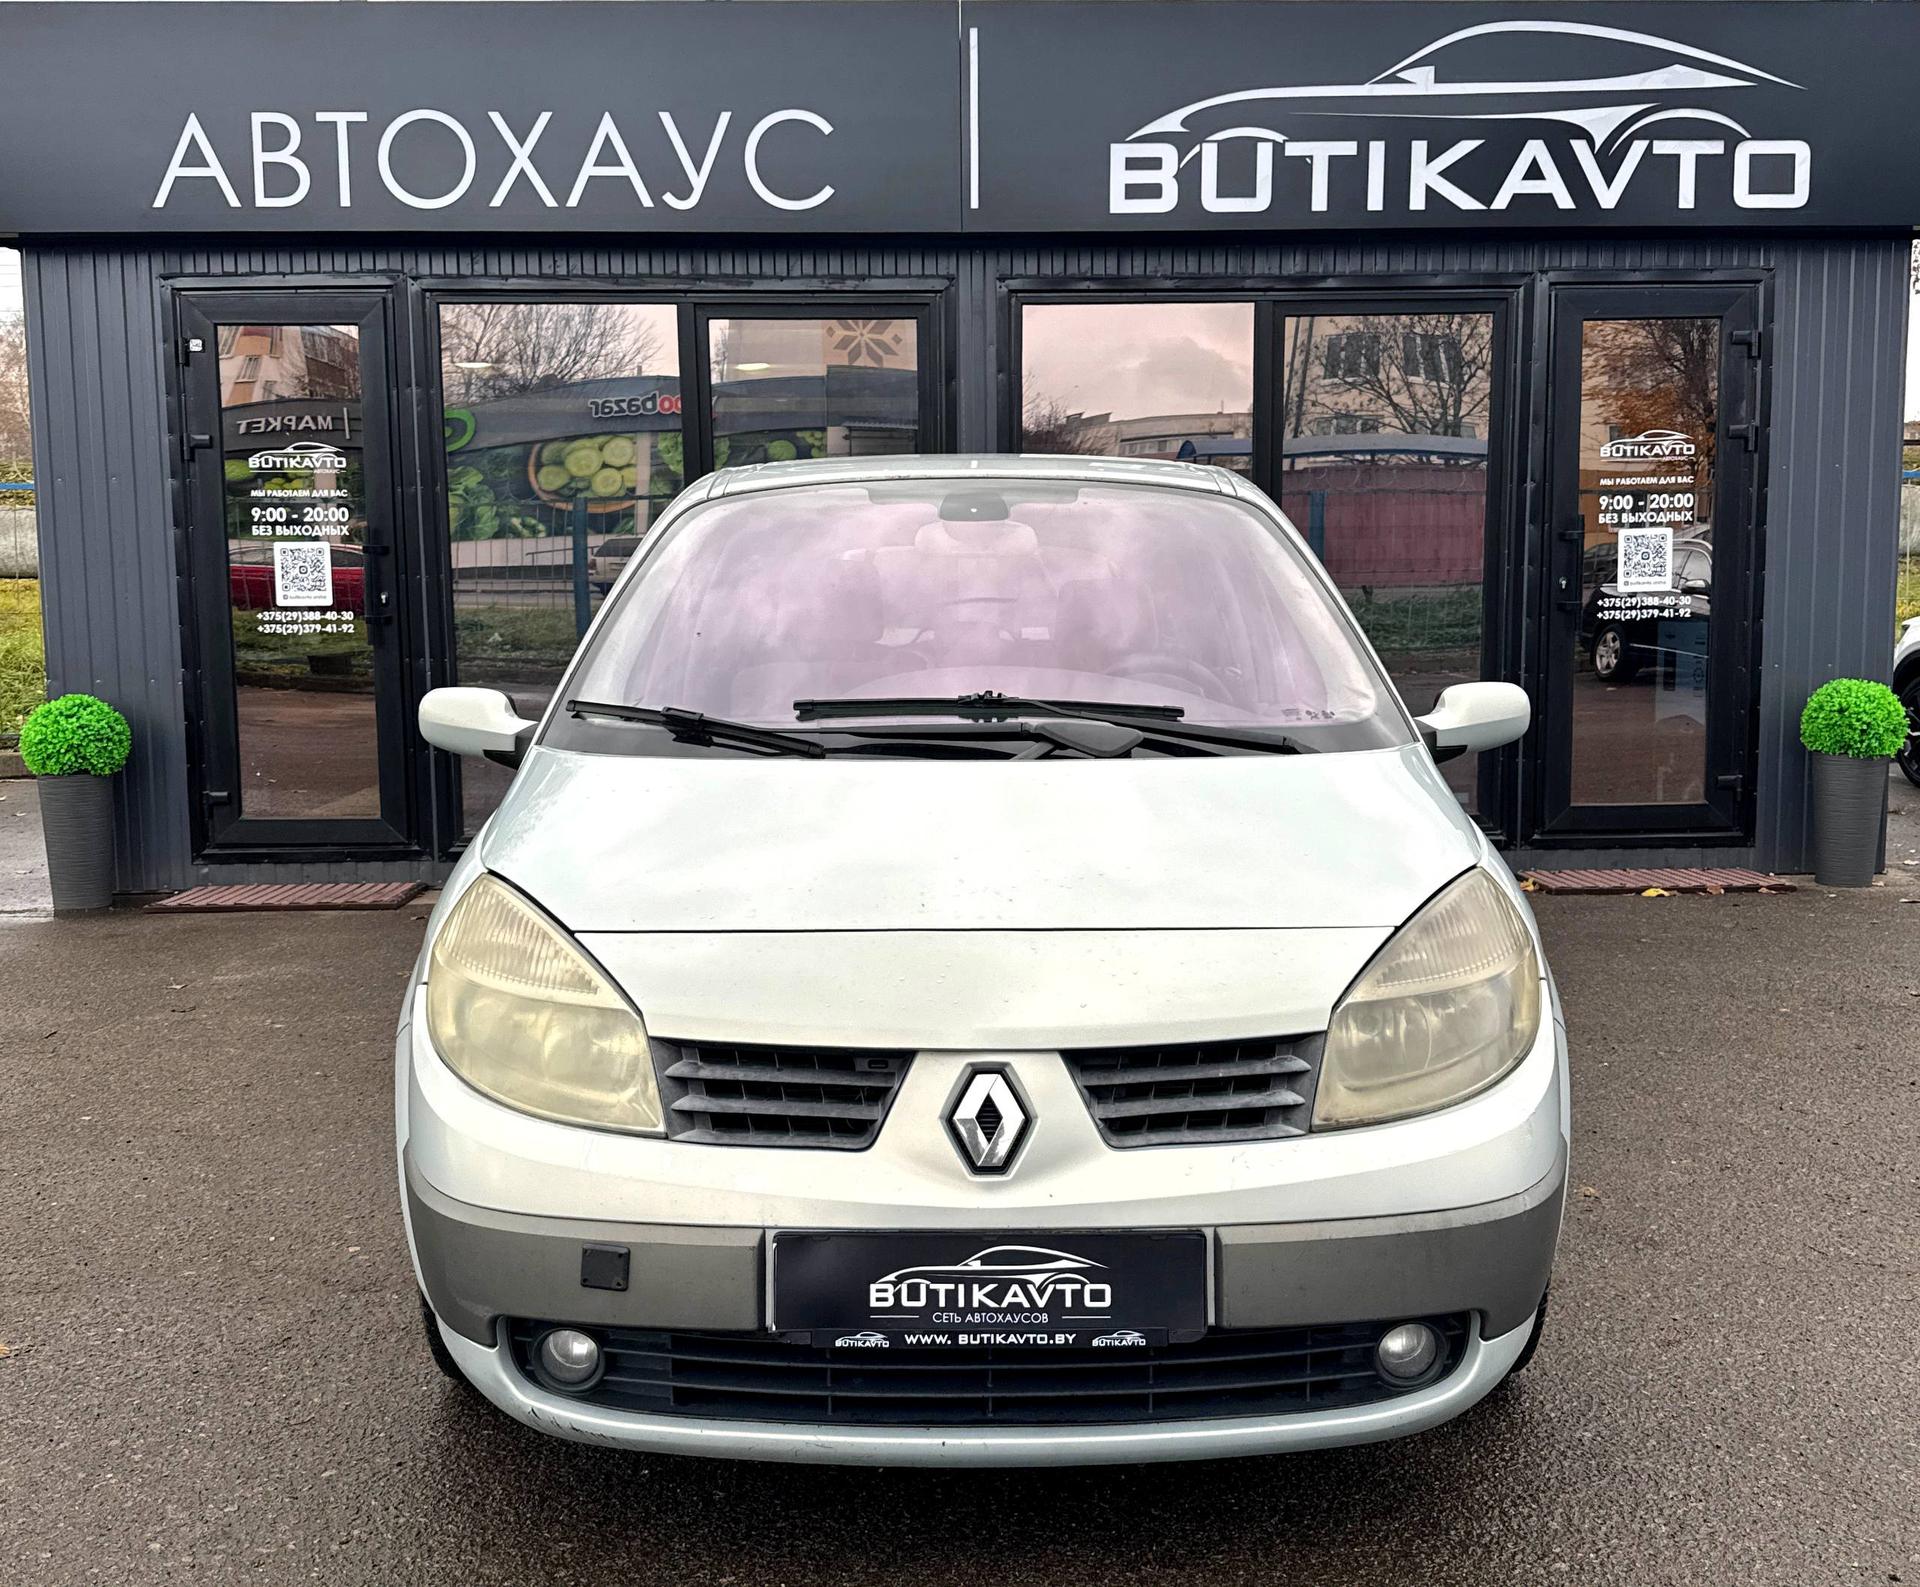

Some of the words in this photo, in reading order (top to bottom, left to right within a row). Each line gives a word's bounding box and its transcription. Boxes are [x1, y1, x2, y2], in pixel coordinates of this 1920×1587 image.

[152, 108, 835, 212] АВТОХАУС
[1109, 138, 1811, 215] BUTIKAVTO
[1599, 444, 1696, 457] BUTIKAVTO
[248, 457, 347, 469] BUTIKAVTO
[1600, 478, 1614, 486] МЫ
[1616, 477, 1658, 485] РАБОТАЕМ
[1658, 476, 1676, 485] ДЛЯ
[1677, 476, 1695, 484] ВАС
[250, 490, 266, 498] МЫ
[311, 490, 330, 498] ДЛЯ
[1599, 495, 1634, 510] 9:00
[1649, 493, 1694, 509] 20:00
[251, 507, 287, 522] 9:00
[303, 507, 349, 522] 20:00
[1598, 513, 1618, 524] БЕЗ
[1621, 511, 1693, 523] ВЫХОДНЫХ
[252, 525, 272, 536] БЕЗ
[275, 525, 350, 537] ВЫХОДНЫХ
[1597, 596, 1692, 608] +375(29)388-40-30
[256, 611, 355, 622] +375(29)388-40-30
[1597, 608, 1692, 620] +375(29)379-41-92
[256, 624, 355, 635] +375(29)379-41-92
[869, 1283, 1112, 1308] BUTIKAVTO
[932, 1312, 962, 1324] СЕТЬ
[965, 1312, 1049, 1324] АВТОХАУСОВ
[835, 1339, 890, 1348] BUTIKAVTO
[904, 1334, 952, 1345] WWW.
[958, 1333, 1077, 1345] BUTIKAVTO.BY
[1092, 1338, 1146, 1347] BUTIKAVTO
